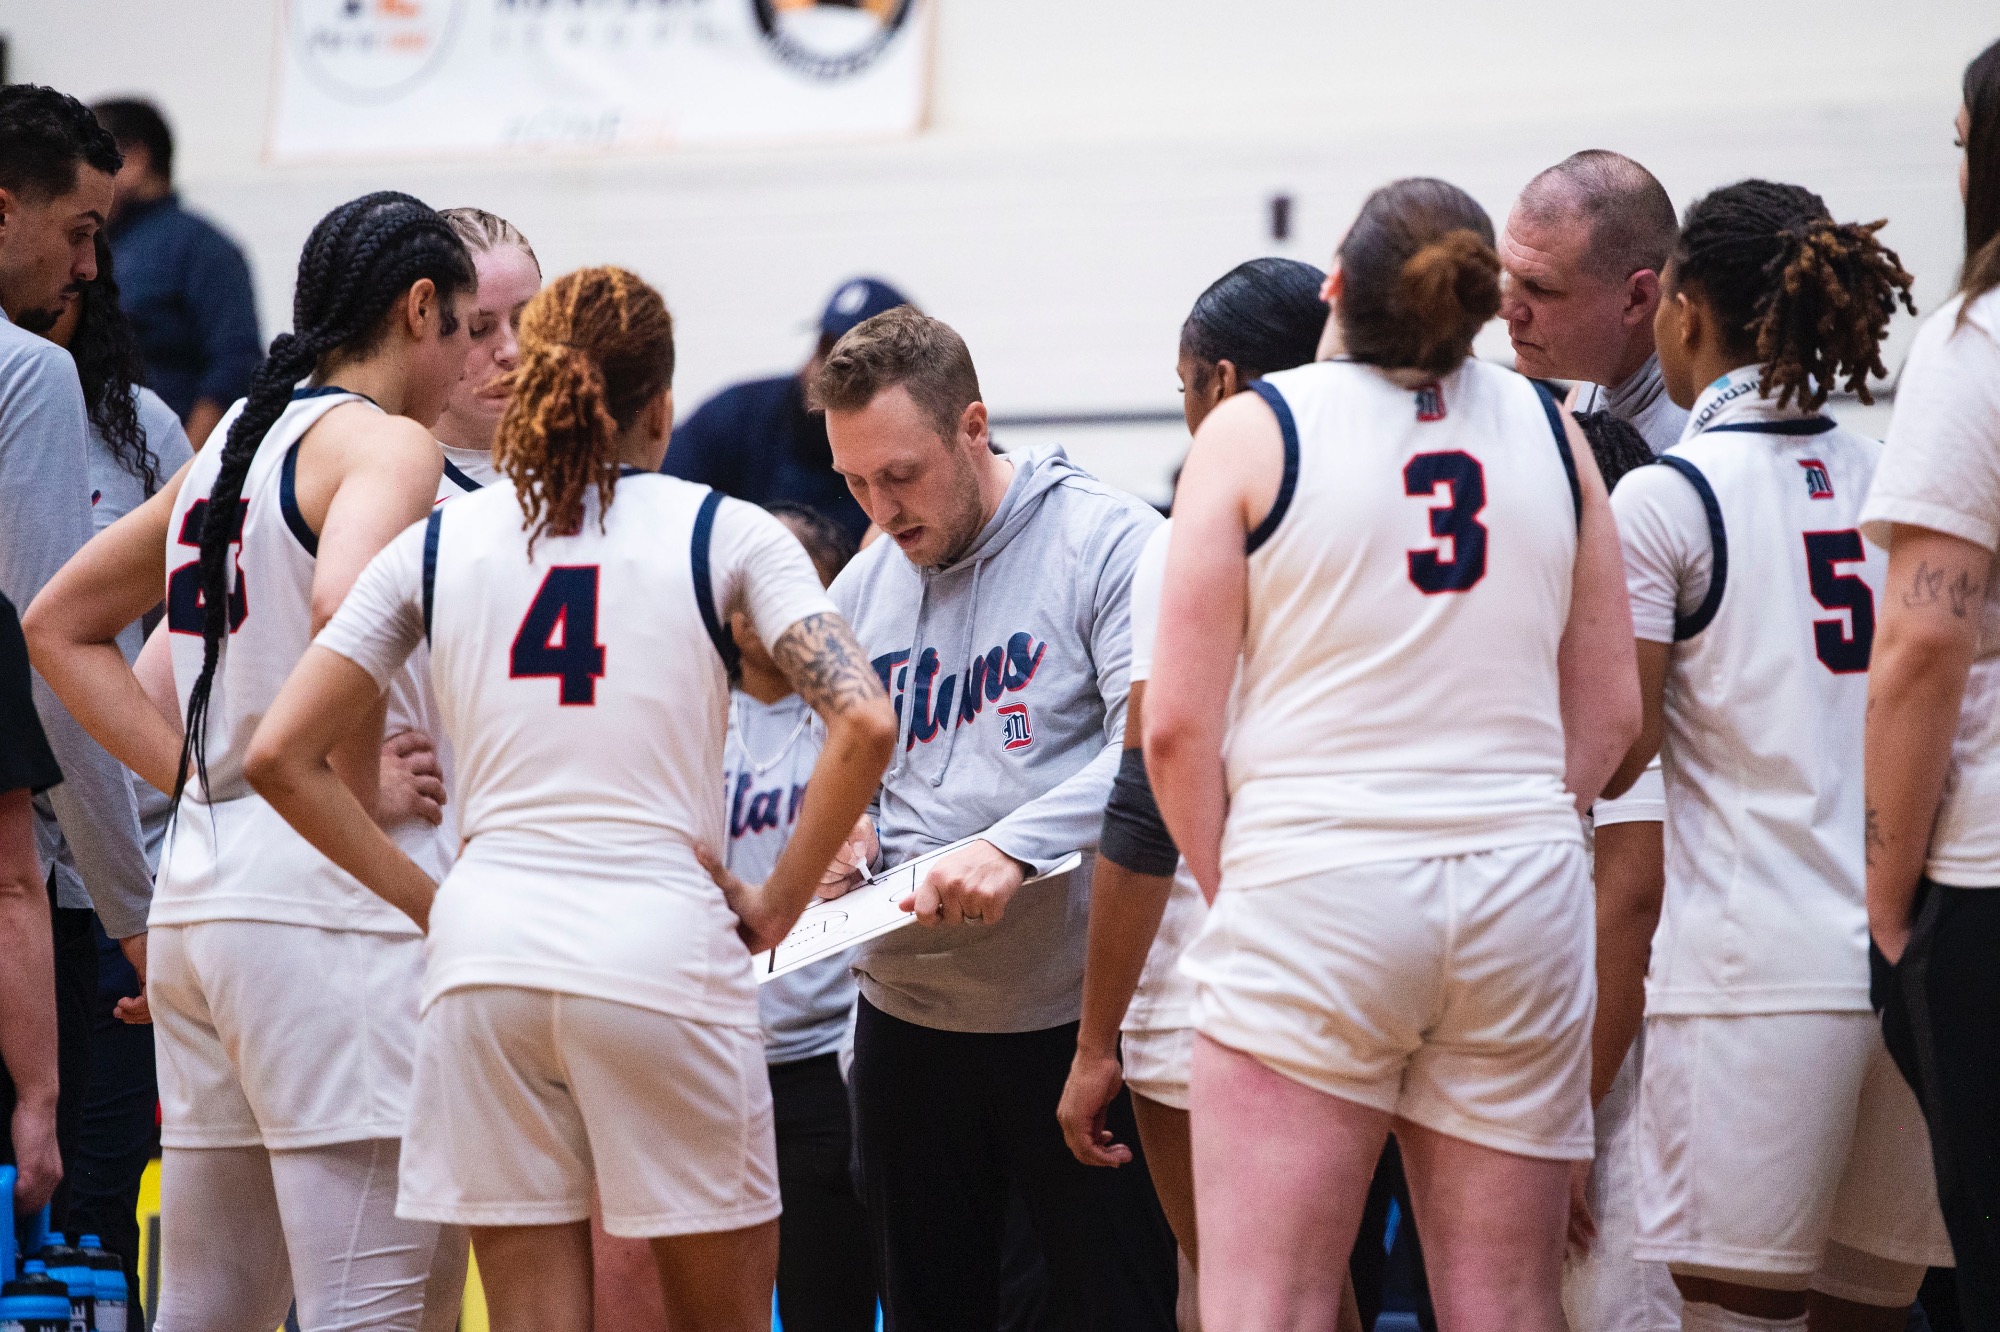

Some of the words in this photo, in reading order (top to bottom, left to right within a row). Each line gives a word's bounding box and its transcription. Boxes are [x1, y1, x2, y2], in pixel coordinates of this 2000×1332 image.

[1402, 449, 1488, 594] 3
[508, 564, 607, 707] 4
[1802, 528, 1877, 675] 5
